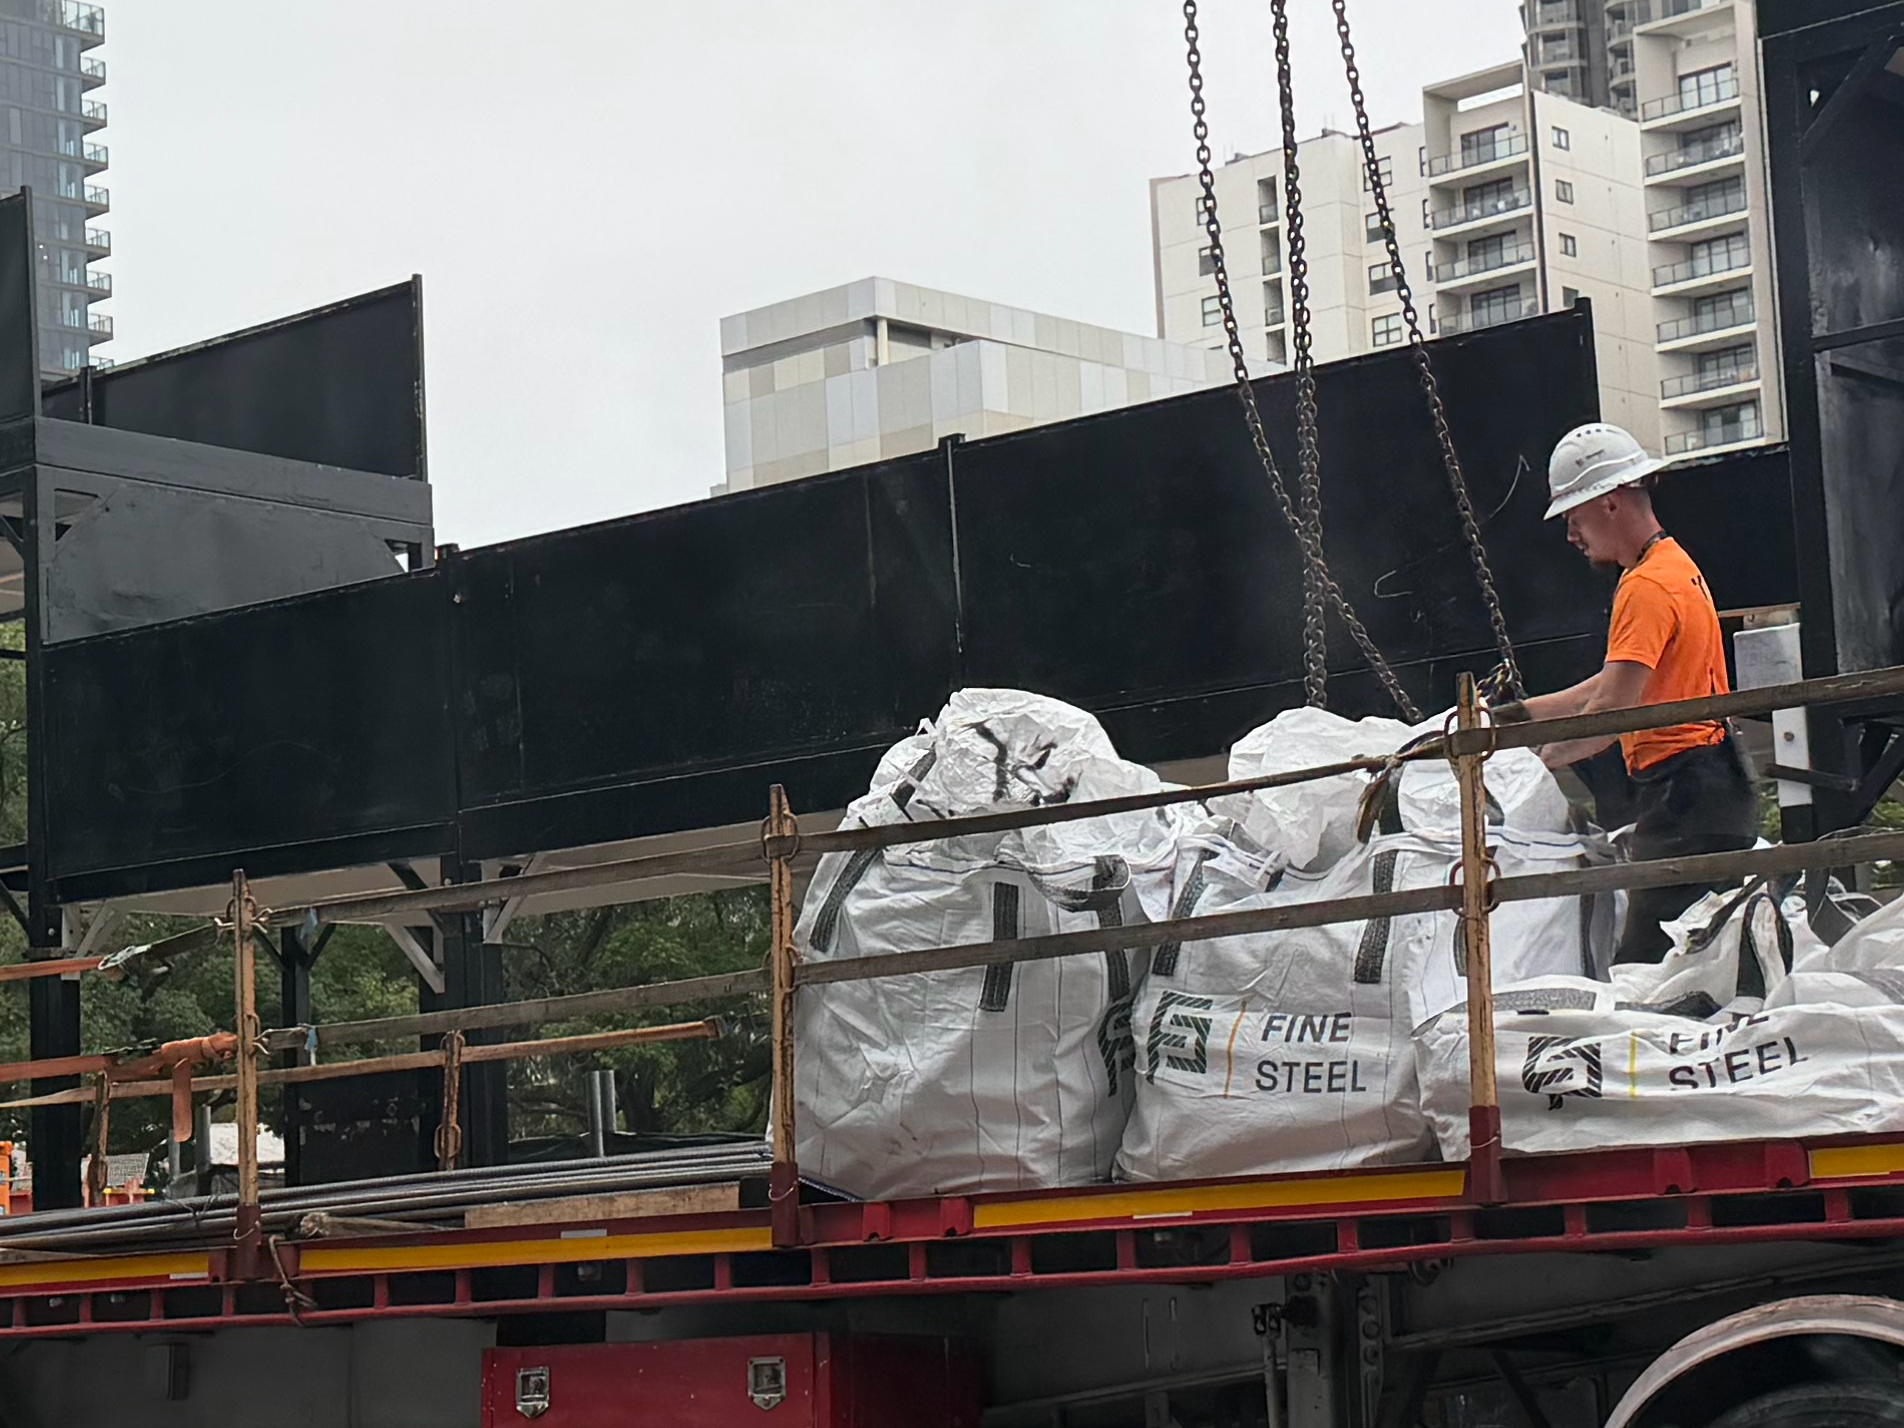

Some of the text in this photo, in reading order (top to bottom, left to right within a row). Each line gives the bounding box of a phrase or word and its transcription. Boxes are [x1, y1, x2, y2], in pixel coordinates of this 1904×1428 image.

[1261, 1011, 1352, 1043] FINE
[1254, 1059, 1367, 1094] STEEL
[1668, 1036, 1809, 1091] STEEL
